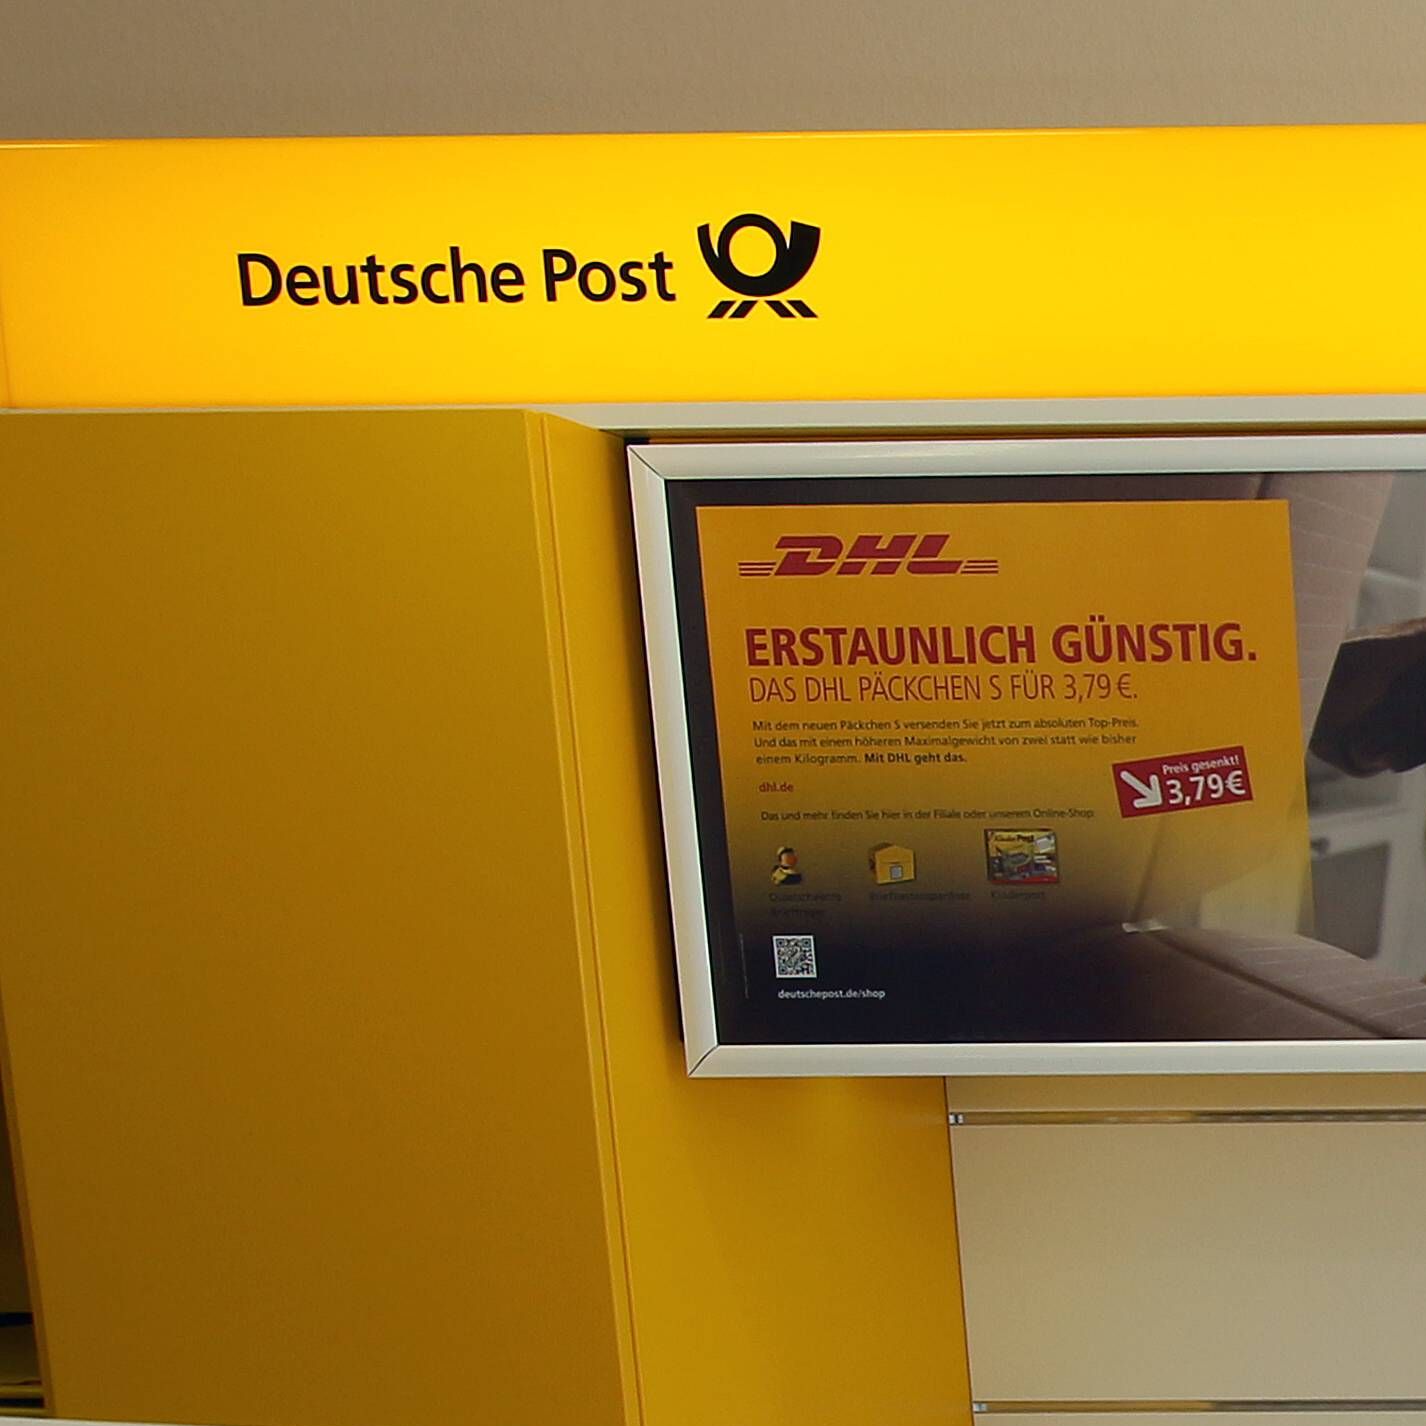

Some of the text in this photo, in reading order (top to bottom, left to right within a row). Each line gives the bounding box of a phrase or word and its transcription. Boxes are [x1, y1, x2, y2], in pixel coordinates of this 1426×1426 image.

[237, 246, 676, 306] Deutsche Post
[773, 535, 964, 576] DHL
[745, 615, 1257, 667] ERSTAUNLICH GÜNSTIG.
[750, 670, 1138, 703] DAS DHL PÄCKCHEN S FÜR 3,79 €.
[753, 721, 772, 731] Mit
[775, 720, 799, 730] dem
[802, 722, 837, 730] neuen
[840, 719, 891, 730] Päckchen
[894, 720, 901, 730] S
[902, 719, 960, 730] versenden
[962, 719, 978, 729] Sie
[982, 718, 1006, 731] jetzt
[1008, 720, 1031, 728] zum
[1033, 718, 1086, 728] absoluten
[754, 734, 1137, 749] Und das mit einem höheren Maximalgewicht von zwei statt wie bisher
[756, 752, 968, 767] einem Kilogramm. Mit DHL geht das.
[1162, 754, 1240, 775] Preis gesenkt!
[758, 781, 794, 793] dhl.de
[1166, 769, 1247, 806] 3,79€
[761, 811, 779, 821] Das
[781, 810, 801, 820] und
[777, 988, 886, 1001] deutschepost.de/shop
